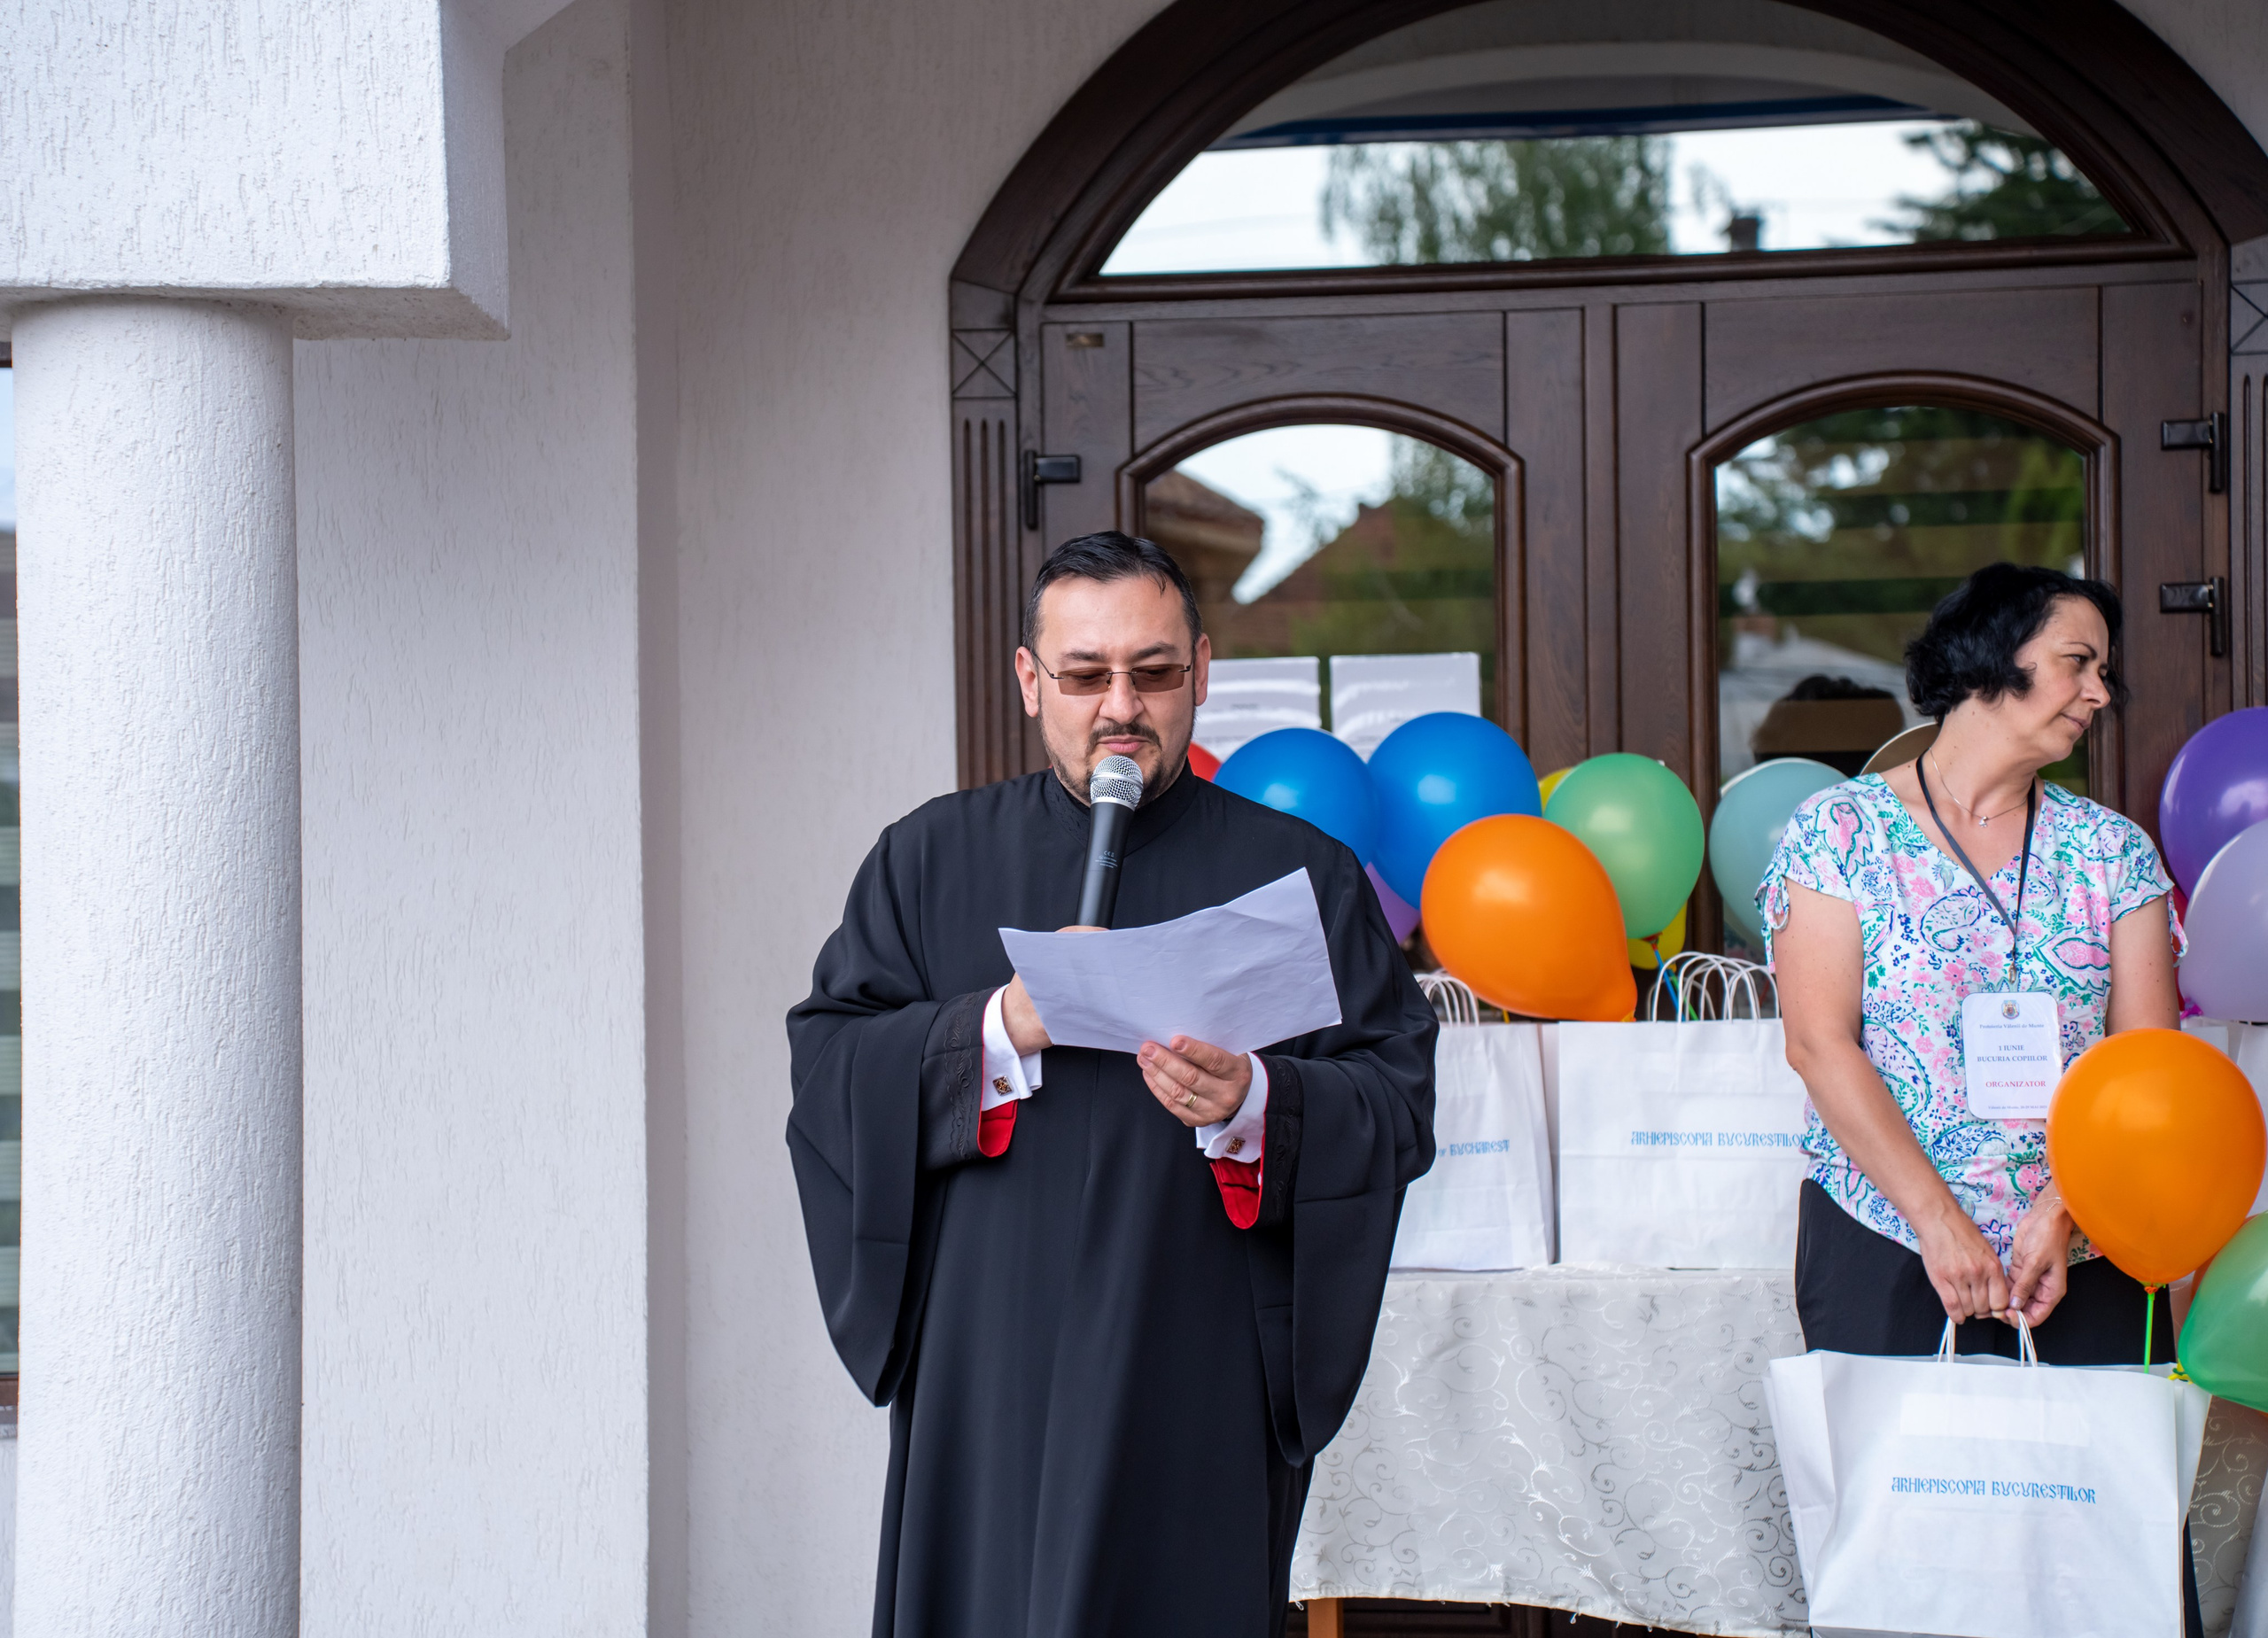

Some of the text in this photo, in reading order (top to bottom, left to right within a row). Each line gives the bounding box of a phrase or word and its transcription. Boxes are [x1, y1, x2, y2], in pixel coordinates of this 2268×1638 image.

[1631, 1131, 1713, 1146] ARHIEPISCOPIA
[1449, 1139, 1510, 1157] BUCHAREST
[1891, 1476, 1985, 1495] ARHIEPISCOPIA
